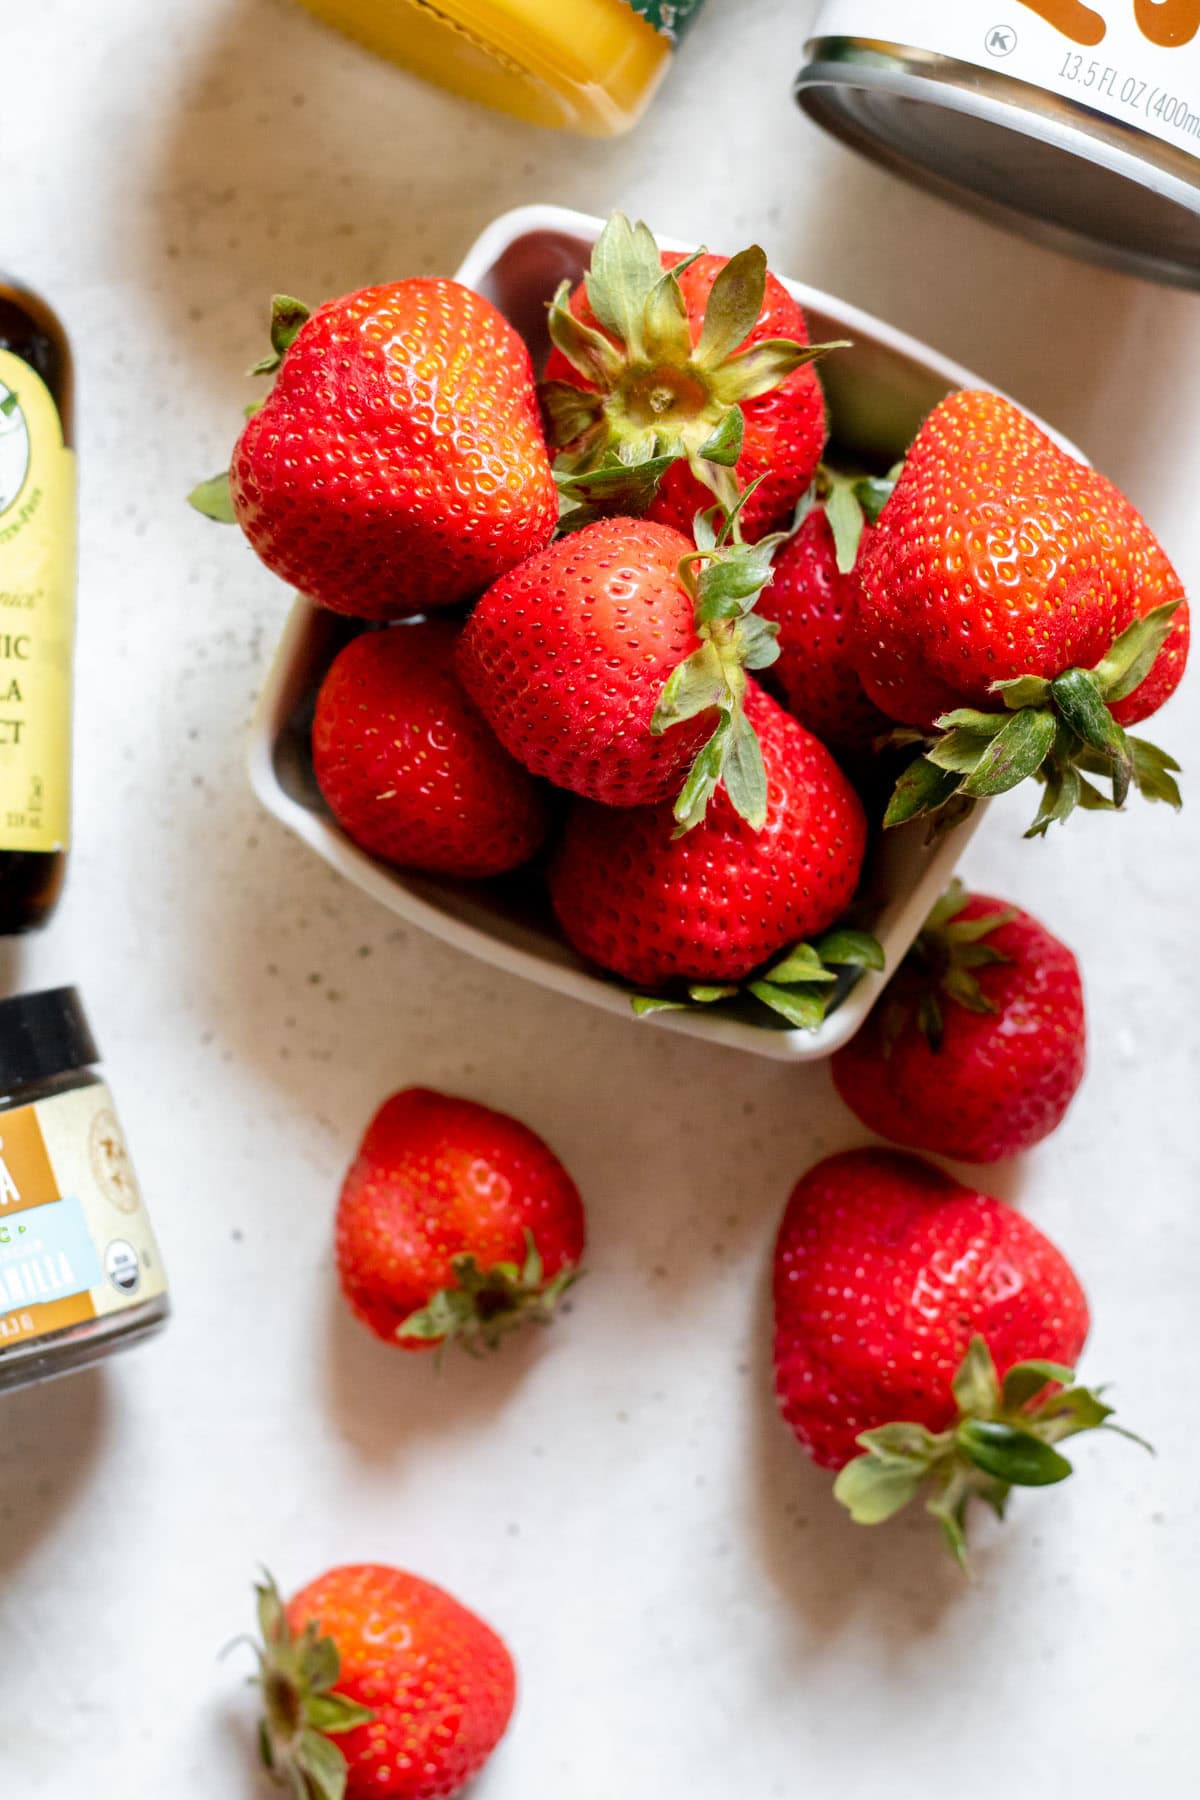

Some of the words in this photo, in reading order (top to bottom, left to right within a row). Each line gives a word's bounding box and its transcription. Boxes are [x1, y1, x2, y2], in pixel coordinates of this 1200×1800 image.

[1058, 52, 1100, 87] 13.5
[1097, 67, 1118, 97] FL
[1120, 77, 1147, 109] OZ
[0, 634, 31, 660] IC
[0, 678, 23, 703] A
